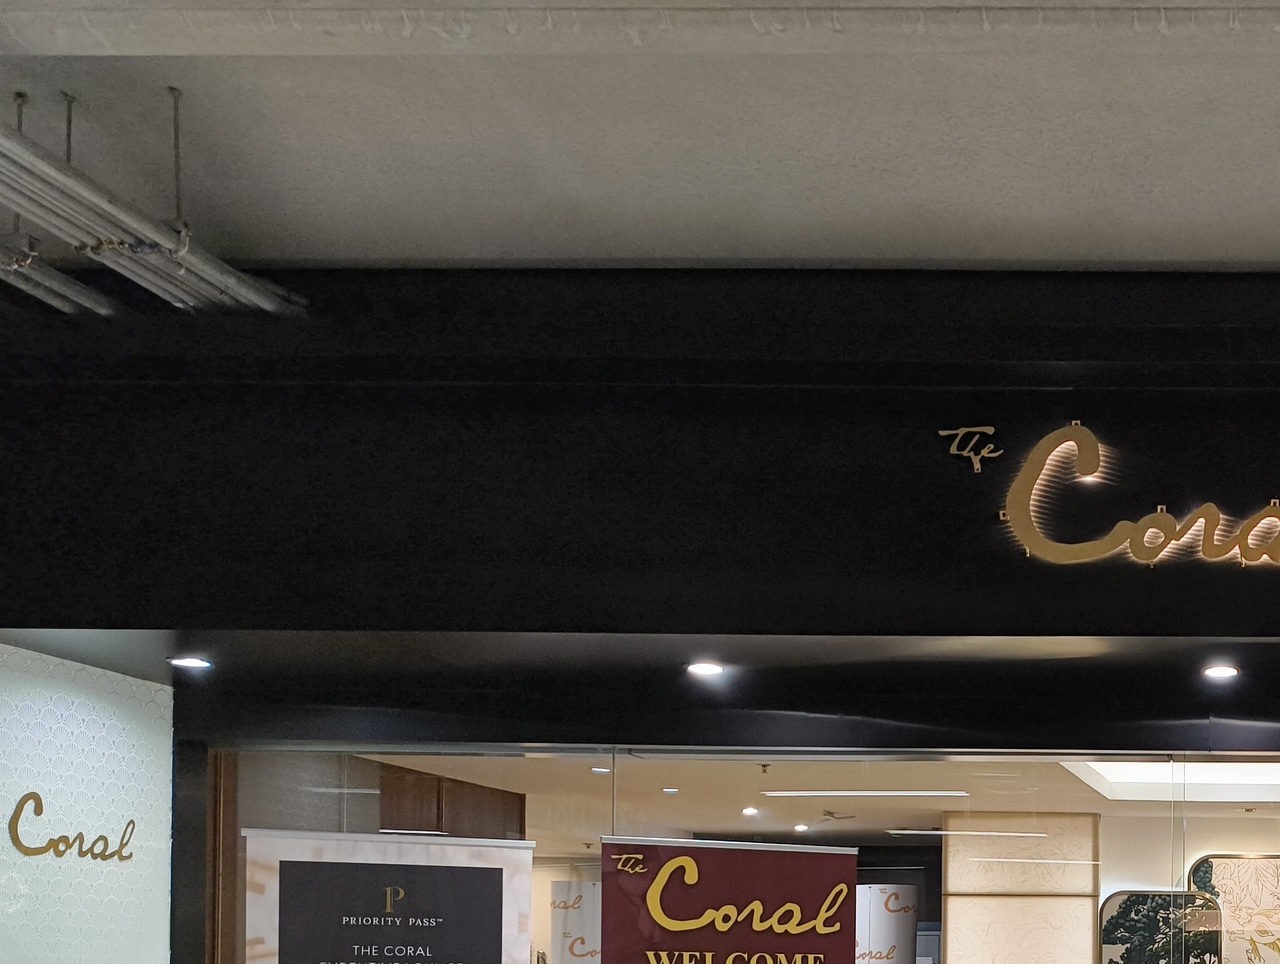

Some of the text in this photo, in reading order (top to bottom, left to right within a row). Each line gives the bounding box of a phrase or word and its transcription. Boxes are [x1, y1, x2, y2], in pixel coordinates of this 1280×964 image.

[938, 426, 1003, 458] The
[8, 792, 135, 861] Coral
[611, 854, 848, 934] The Coral
[342, 916, 402, 926] PRIORITY
[353, 945, 432, 957] THE CORAL
